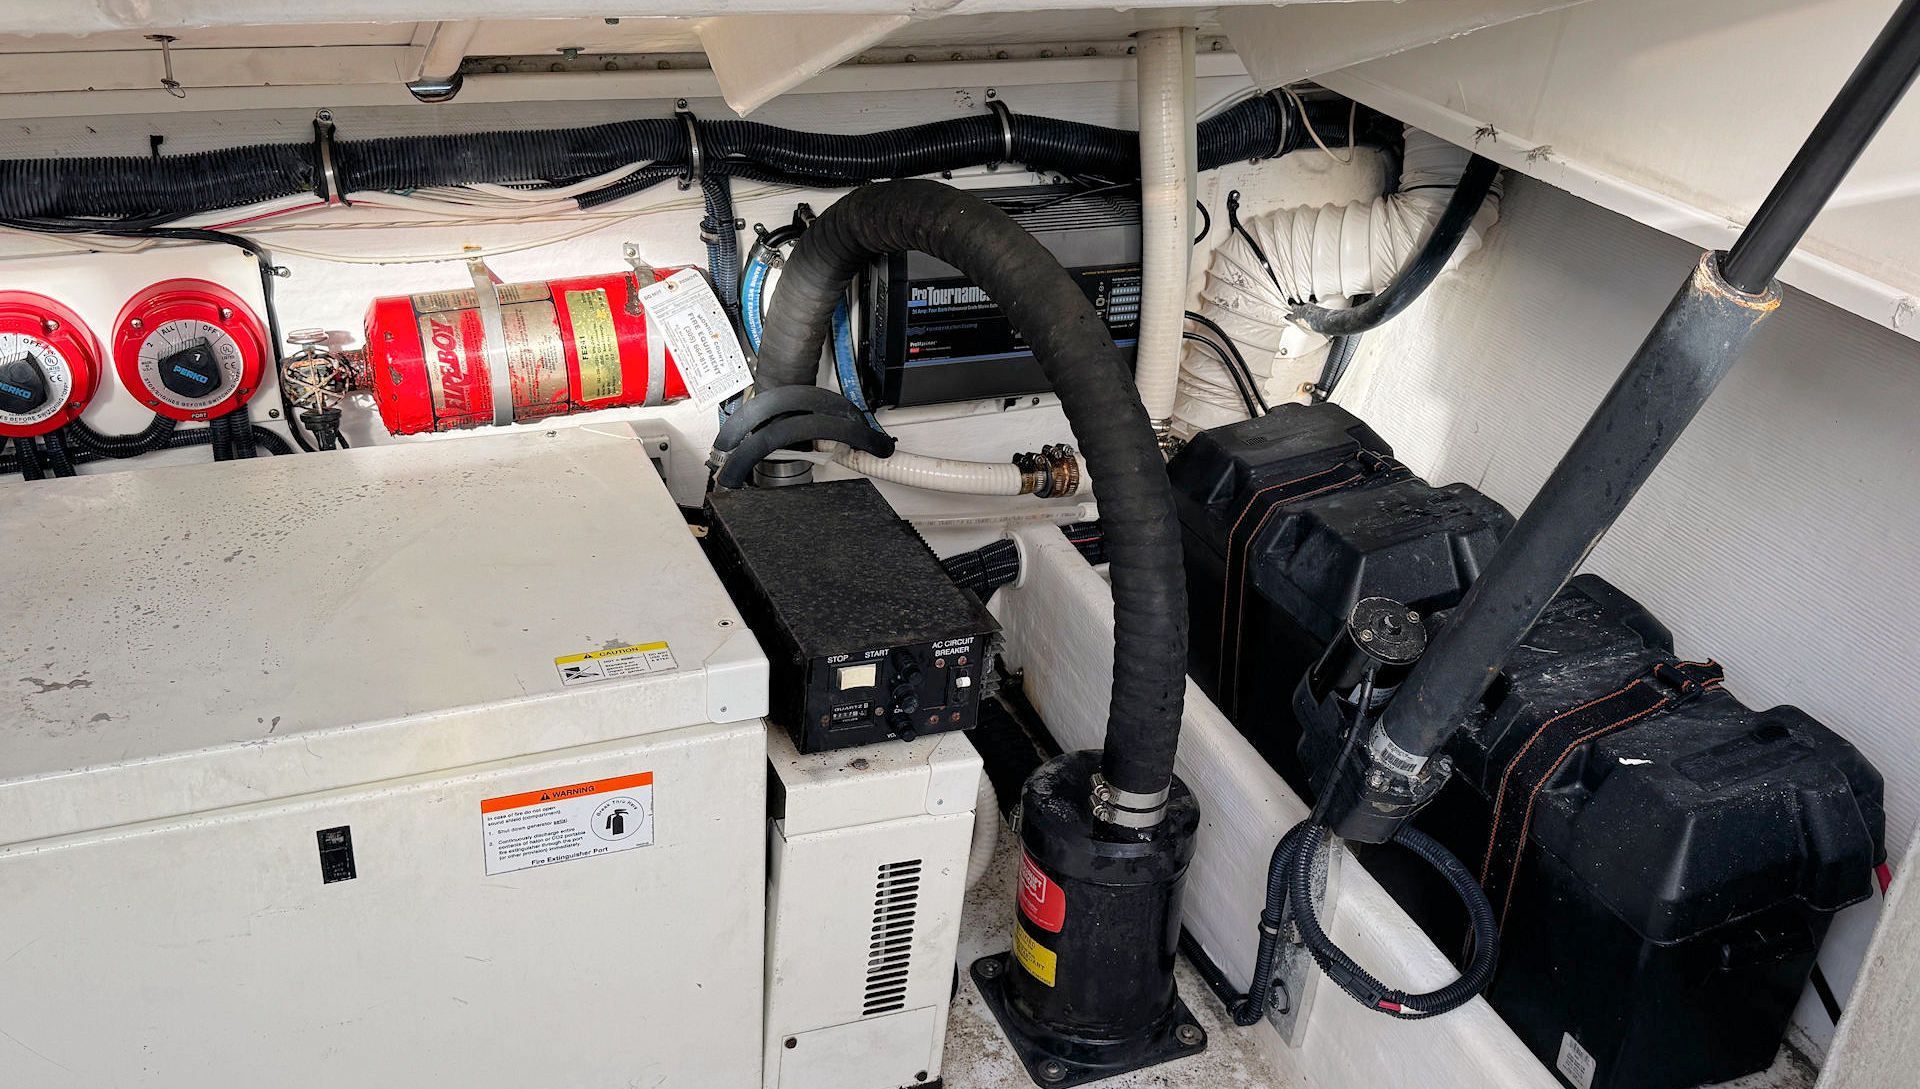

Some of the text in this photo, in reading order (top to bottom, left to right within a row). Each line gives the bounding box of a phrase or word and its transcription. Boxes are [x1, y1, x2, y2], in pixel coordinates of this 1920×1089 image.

[161, 325, 176, 336] ALL
[203, 325, 218, 334] OFF
[682, 325, 697, 344] (305)
[23, 338, 41, 348] OFF
[688, 312, 700, 331] FIRE
[697, 331, 722, 376] EQUIPMENT
[697, 314, 725, 368] MONROE COUNTY
[430, 316, 468, 410] FIREBOY
[50, 374, 63, 383] CE
[173, 365, 209, 384] PERKO
[208, 385, 236, 405] SWITCHING
[9, 414, 37, 423] BEFORE
[37, 397, 65, 419] SWITCHING
[932, 637, 975, 649] AC CIRCUIT
[599, 647, 639, 657] CAUTION
[865, 649, 890, 659] START
[935, 646, 970, 657] BREAKER
[827, 654, 849, 664] STOP
[834, 704, 863, 712] QUARTZ
[552, 786, 595, 799] WARNING
[522, 809, 561, 821] (compartment)
[526, 821, 553, 830] generator
[498, 834, 532, 845] Continuously
[533, 829, 560, 839] discharge
[498, 842, 522, 850] contents
[564, 830, 586, 838] portable
[508, 844, 541, 854] extinguisher
[541, 840, 562, 848] through
[522, 847, 548, 857] provision)
[531, 847, 609, 866] Fire Extinguisher Port
